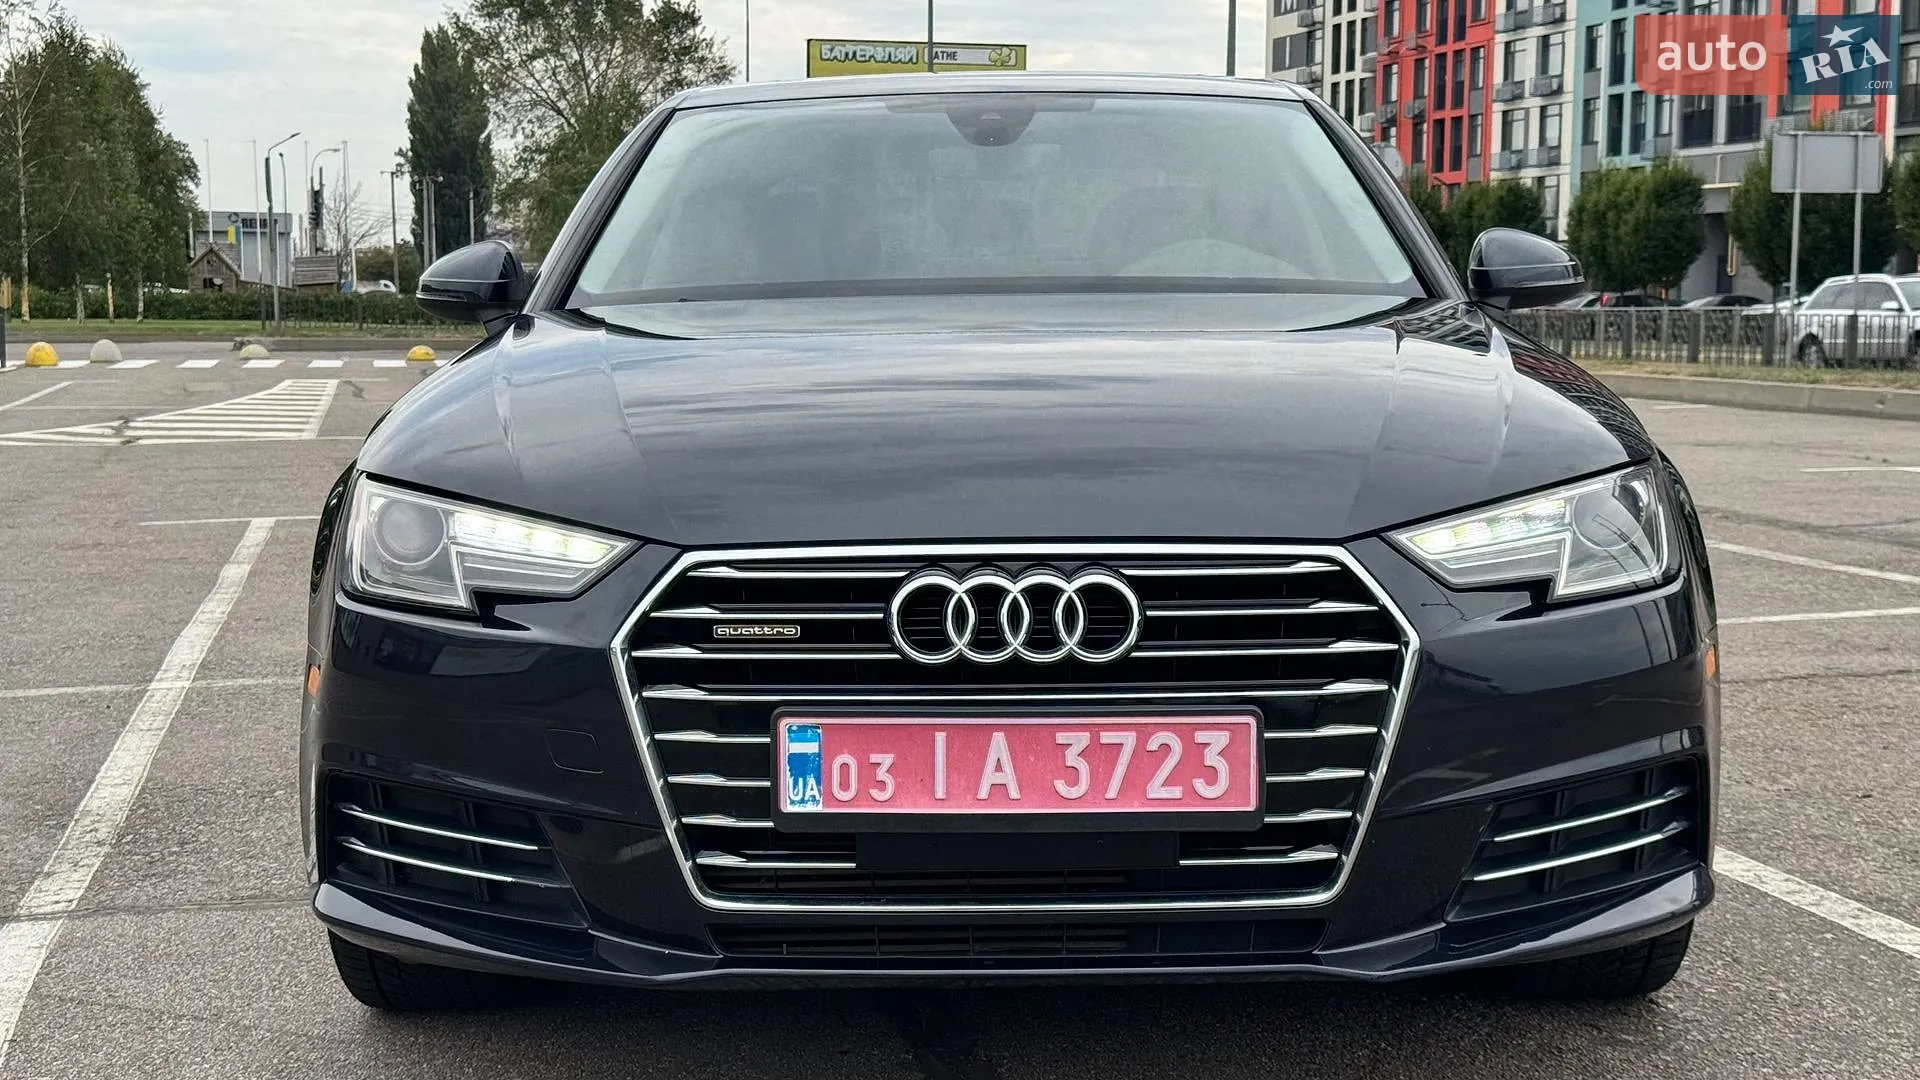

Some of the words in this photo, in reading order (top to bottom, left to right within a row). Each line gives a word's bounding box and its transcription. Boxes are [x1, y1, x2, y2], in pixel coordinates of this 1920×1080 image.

[820, 44, 918, 64] БАТТЕРФЛЯЙ
[717, 626, 796, 637] quattro
[831, 753, 895, 802] 03
[1053, 731, 1231, 800] 3723
[788, 777, 821, 801] UA
